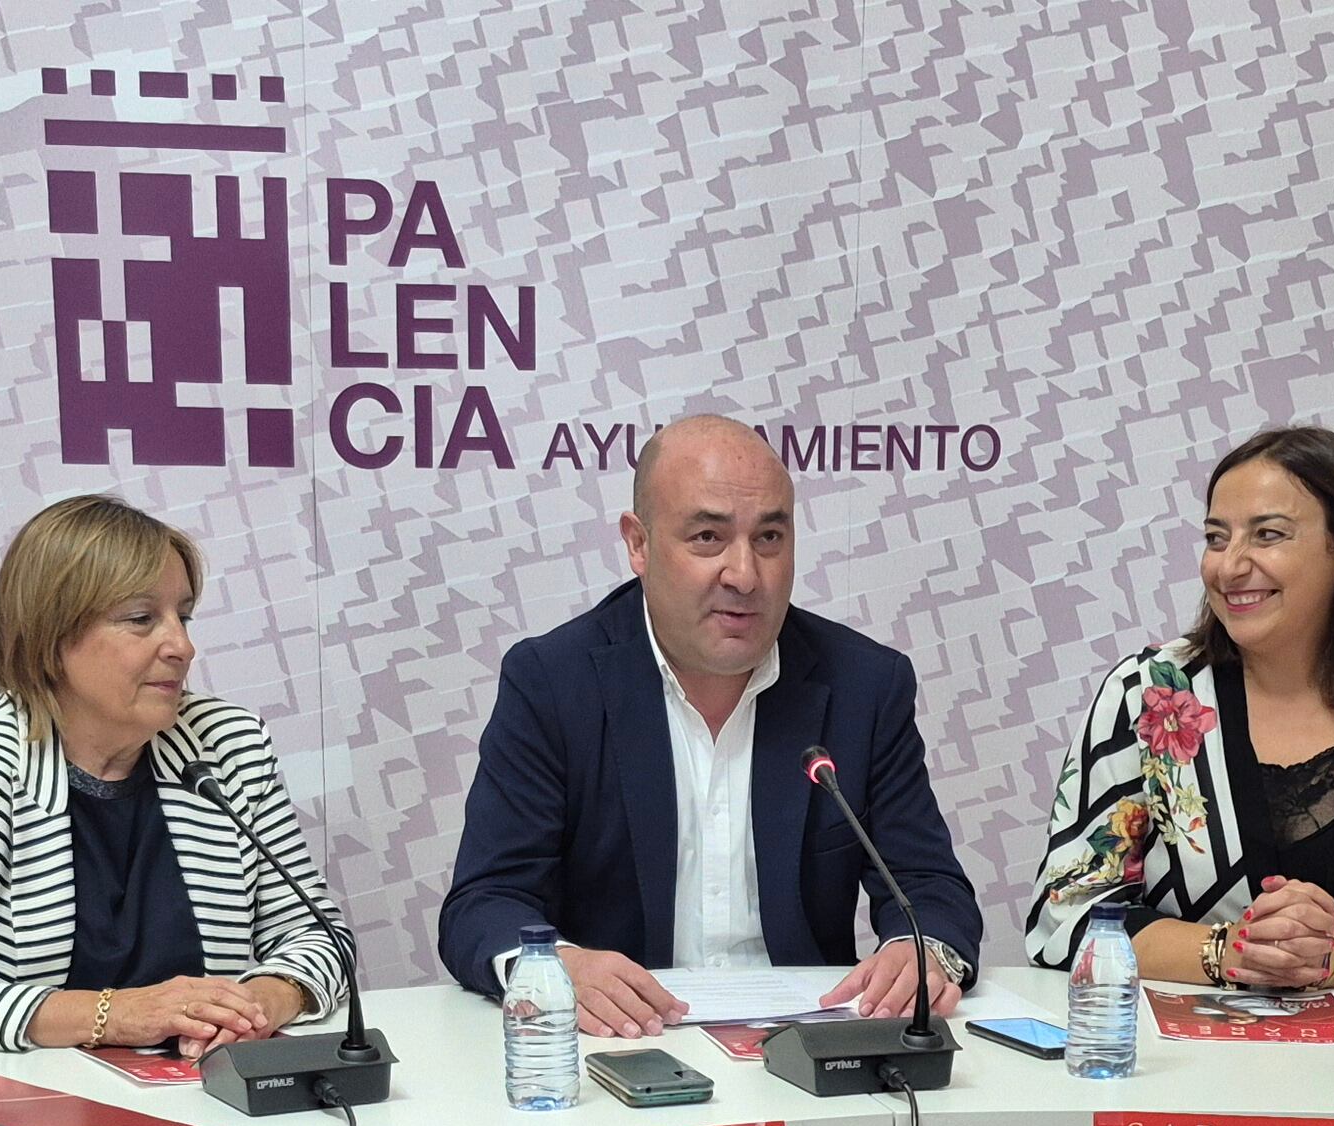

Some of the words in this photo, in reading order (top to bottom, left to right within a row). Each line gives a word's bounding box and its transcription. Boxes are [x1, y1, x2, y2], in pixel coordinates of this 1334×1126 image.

[326, 178, 465, 269] PA
[328, 282, 537, 371] LEN
[328, 382, 515, 470] CIA
[542, 422, 1002, 473] AYUMIENTO
[256, 1076, 294, 1090] OPTIMUS
[825, 1059, 861, 1071] OPTIMUS
